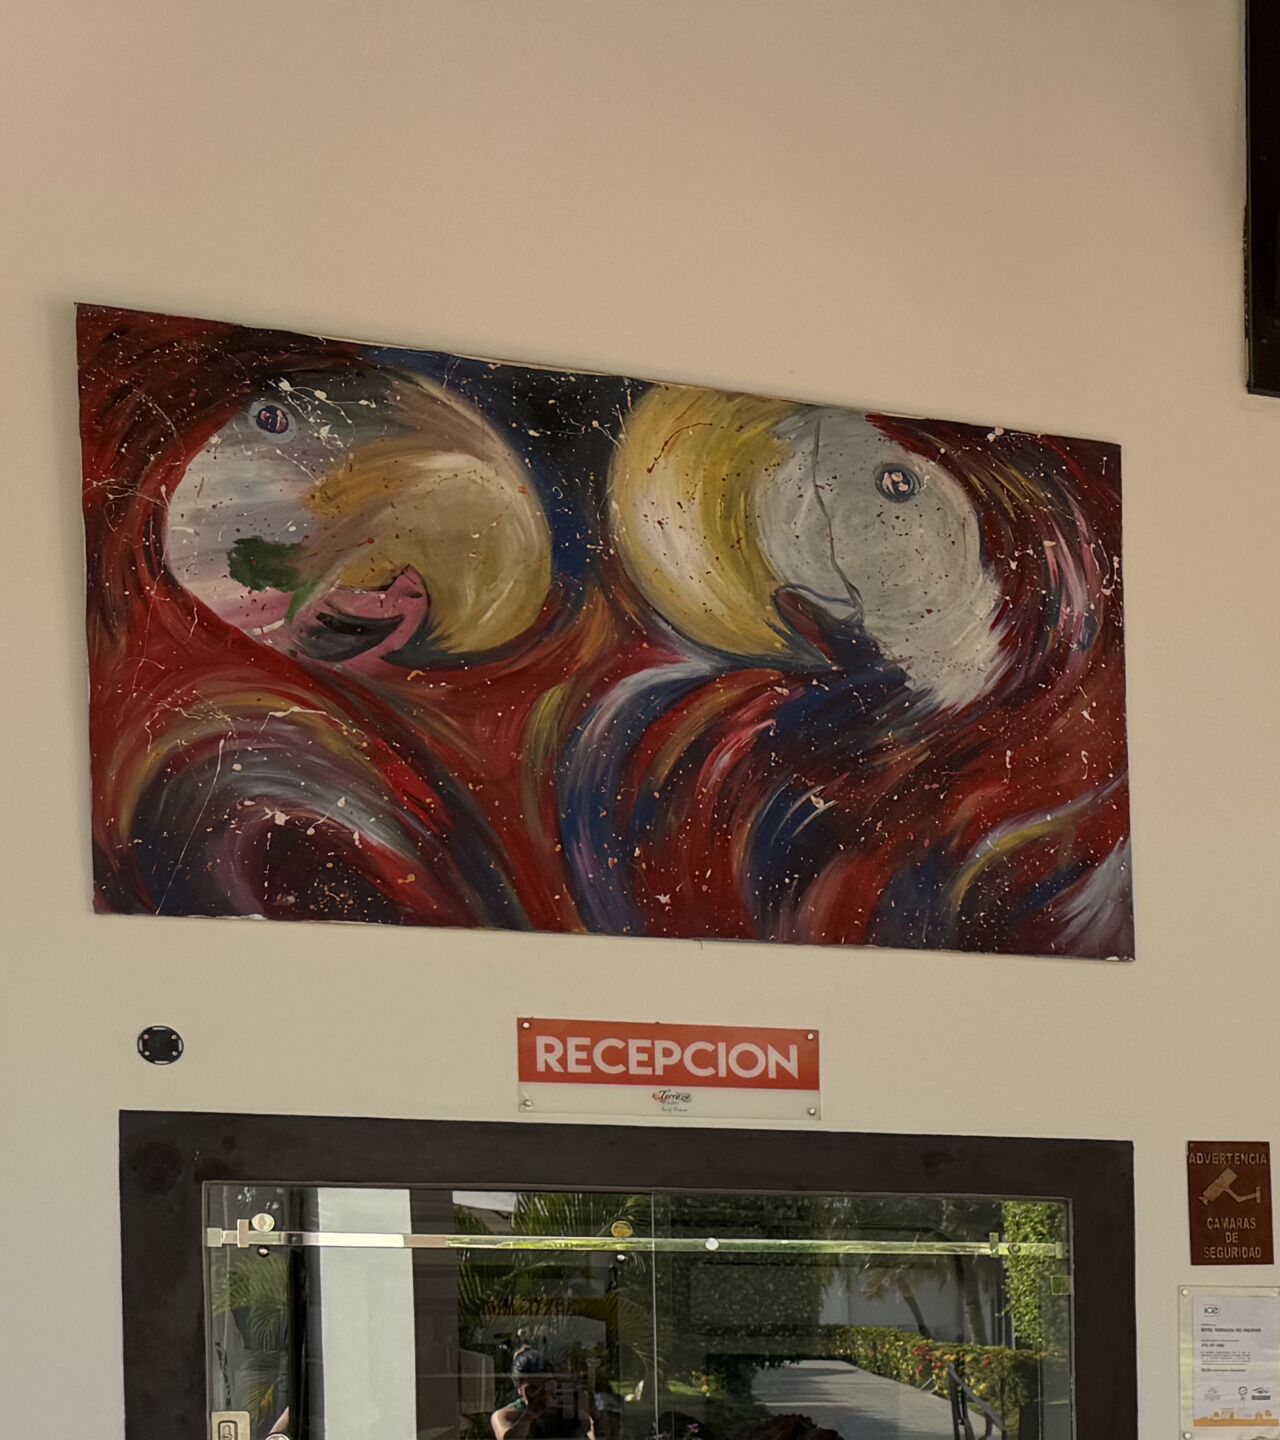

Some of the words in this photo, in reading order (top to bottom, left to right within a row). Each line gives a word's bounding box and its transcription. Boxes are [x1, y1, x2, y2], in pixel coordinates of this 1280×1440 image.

[535, 1035, 799, 1080] RECEPCION
[1189, 1152, 1267, 1165] ADVERTENCIA
[1207, 1217, 1257, 1229] CAMARAS
[1225, 1232, 1239, 1243] DE
[1204, 1246, 1262, 1258] SEGURIDAD
